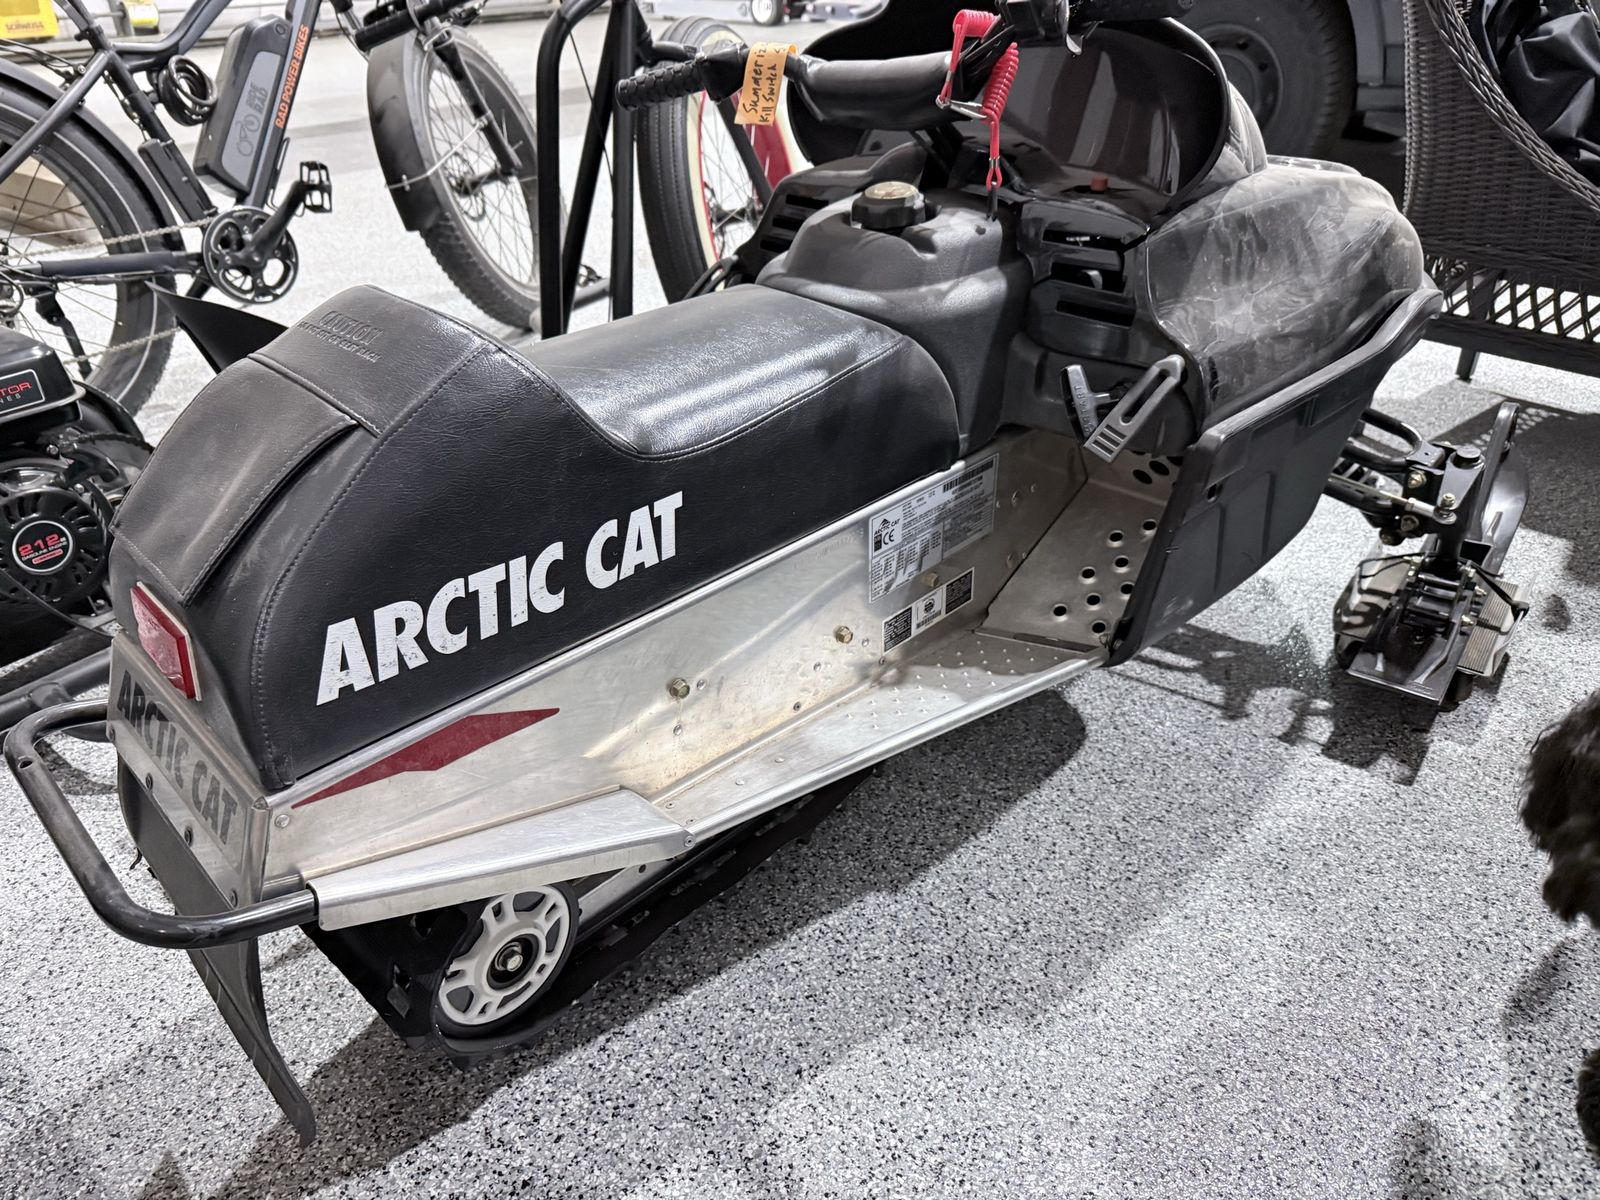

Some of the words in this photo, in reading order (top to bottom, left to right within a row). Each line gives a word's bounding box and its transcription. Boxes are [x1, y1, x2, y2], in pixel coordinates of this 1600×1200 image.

[275, 104, 289, 128] RAD
[282, 59, 300, 102] POWER
[293, 24, 310, 59] BIKES
[762, 63, 777, 102] Switch
[759, 106, 774, 122] Kill
[319, 309, 384, 346] CAUTION
[19, 534, 61, 556] 212
[316, 541, 565, 705] ARCTIC
[586, 491, 683, 589] CAT
[117, 670, 189, 789] ARCTIC
[192, 759, 238, 845] CAT
